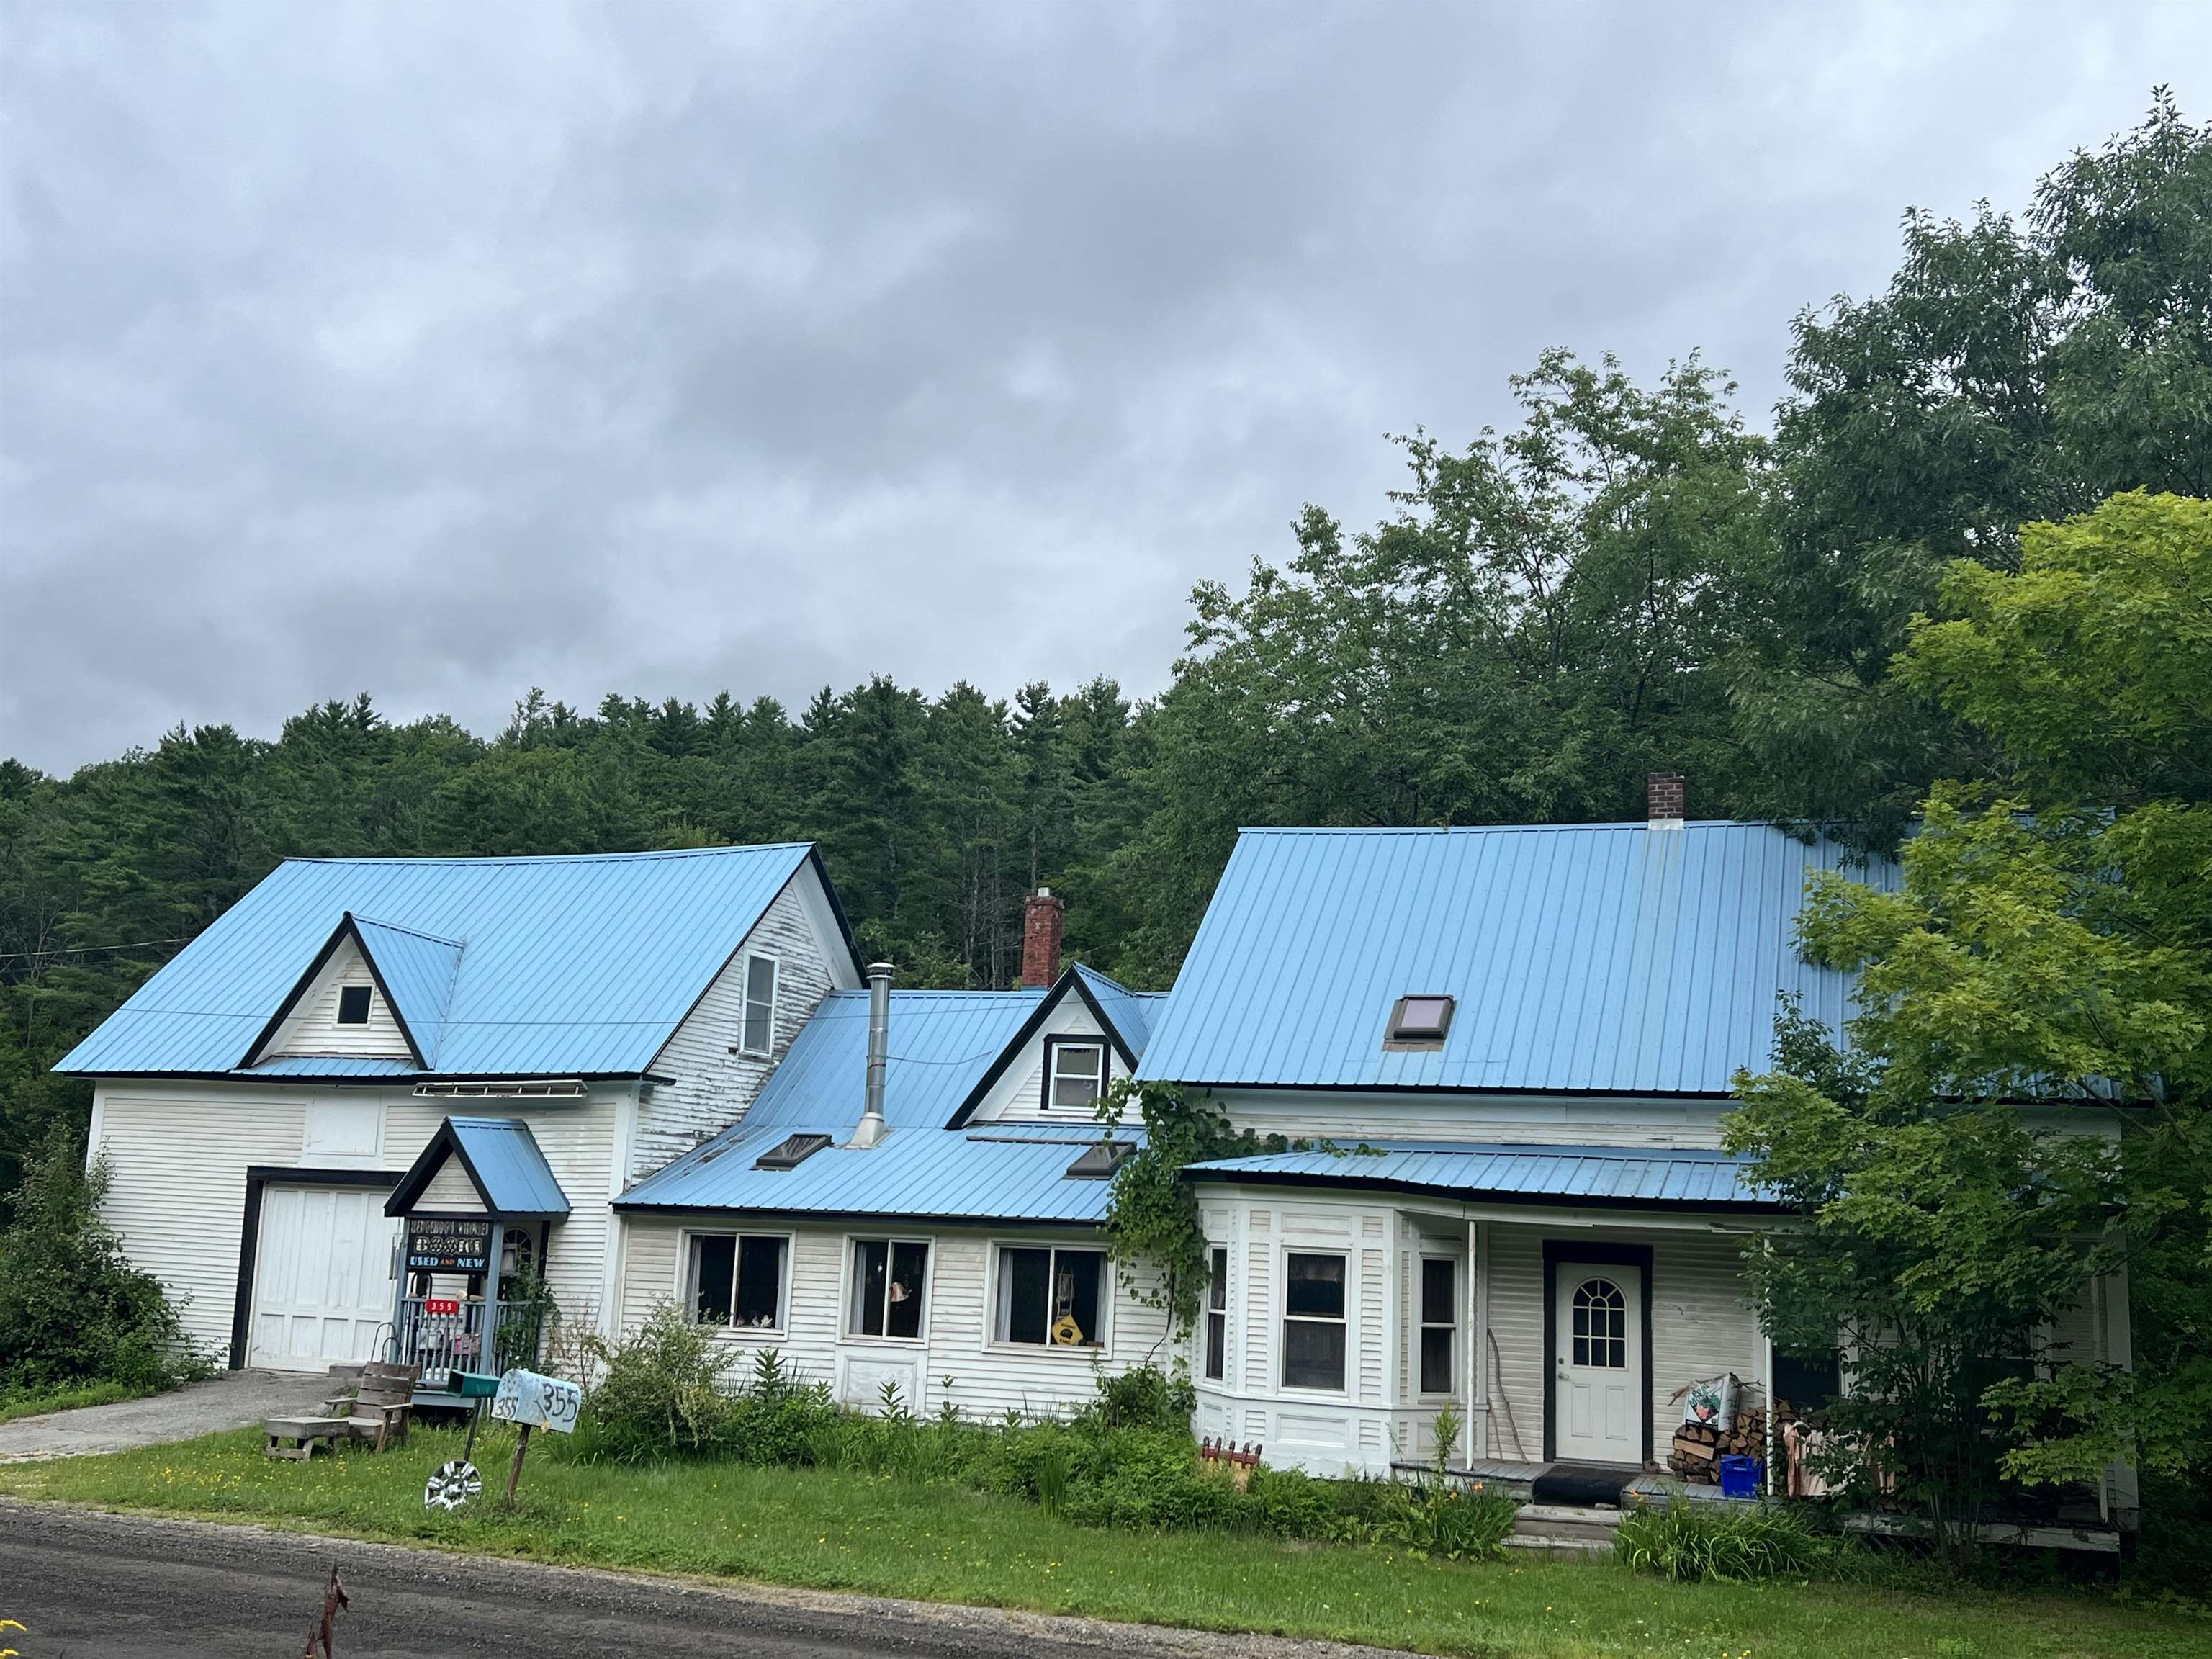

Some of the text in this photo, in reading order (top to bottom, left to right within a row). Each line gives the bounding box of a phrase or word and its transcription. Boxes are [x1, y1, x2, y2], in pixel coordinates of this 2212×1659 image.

[415, 1237, 482, 1254] BOOKS
[410, 1256, 439, 1266] USED
[457, 1258, 485, 1267] NEW
[431, 1302, 452, 1311] 355
[495, 1396, 518, 1419] 355
[541, 1382, 579, 1423] 355
